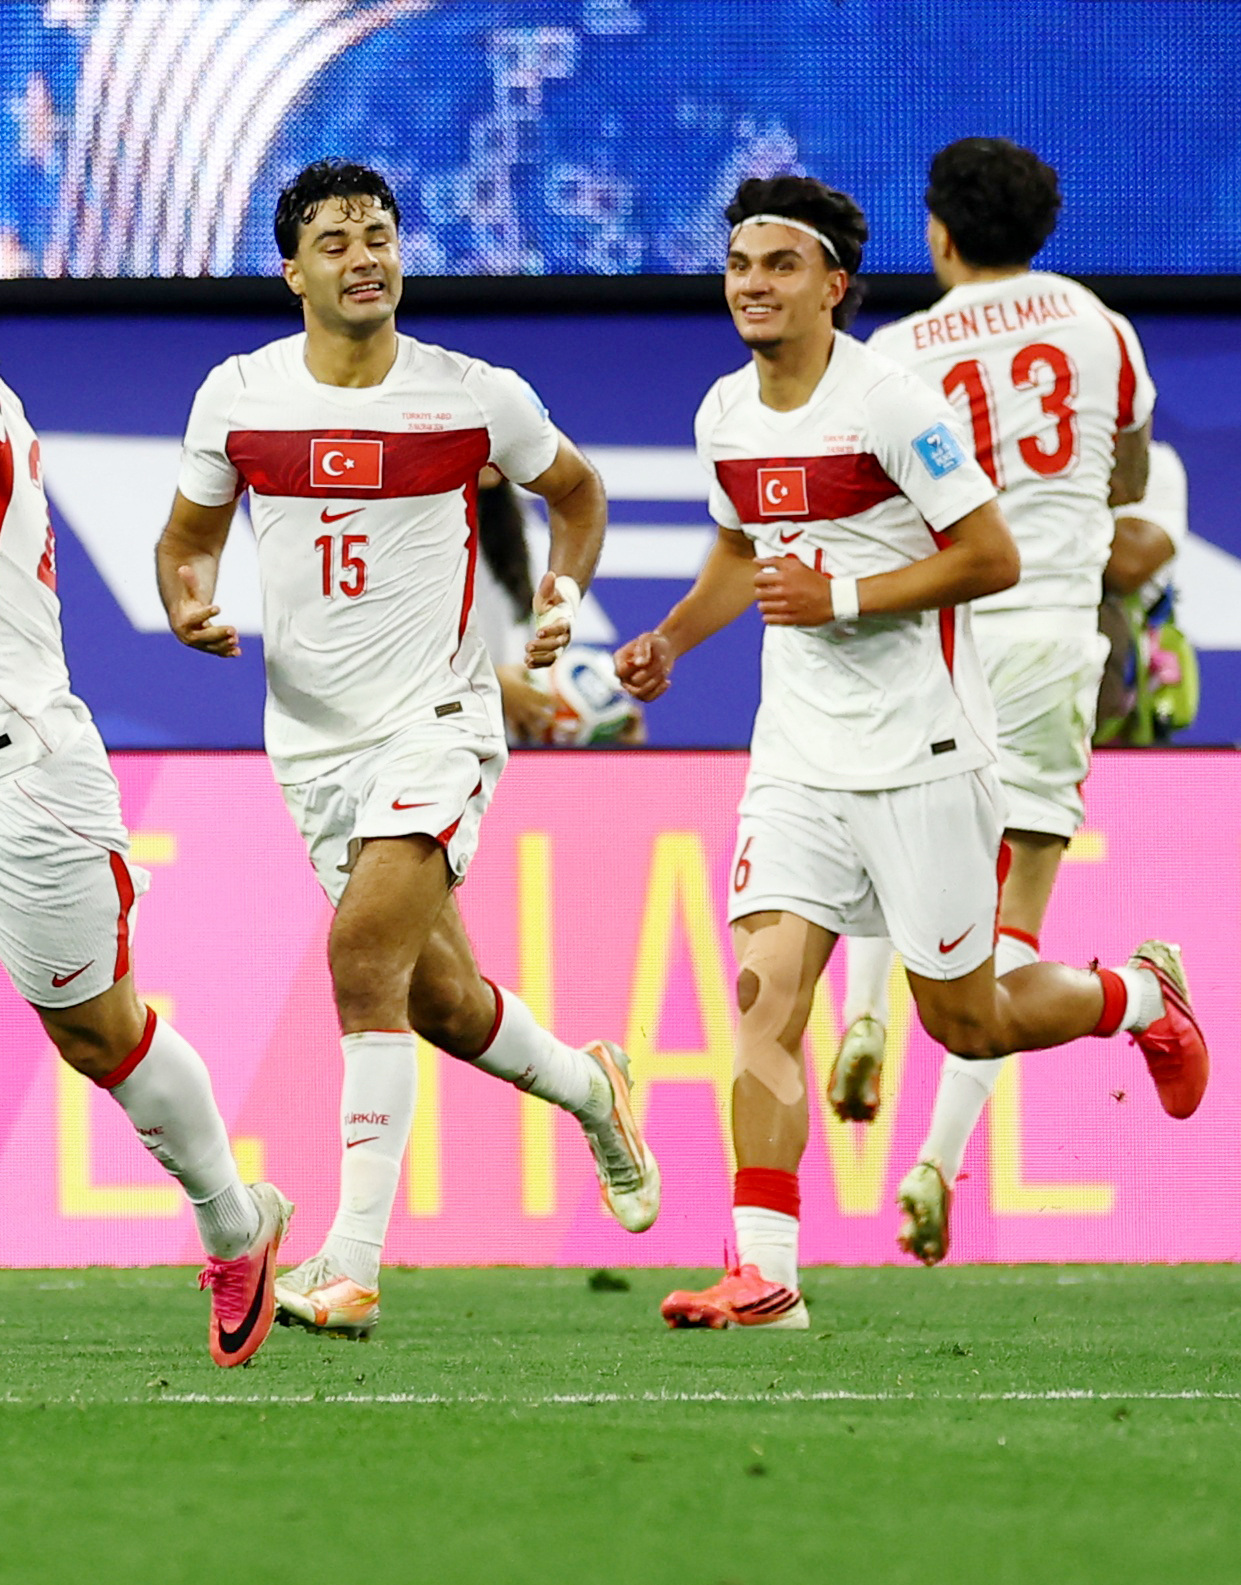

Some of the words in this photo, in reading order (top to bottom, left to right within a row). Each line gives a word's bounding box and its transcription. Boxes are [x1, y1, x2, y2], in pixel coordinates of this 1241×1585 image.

[913, 307, 980, 350] EREN
[983, 292, 1078, 335] ELMALI
[942, 342, 1080, 491] 13
[314, 534, 369, 600] 15
[734, 836, 755, 894] 6
